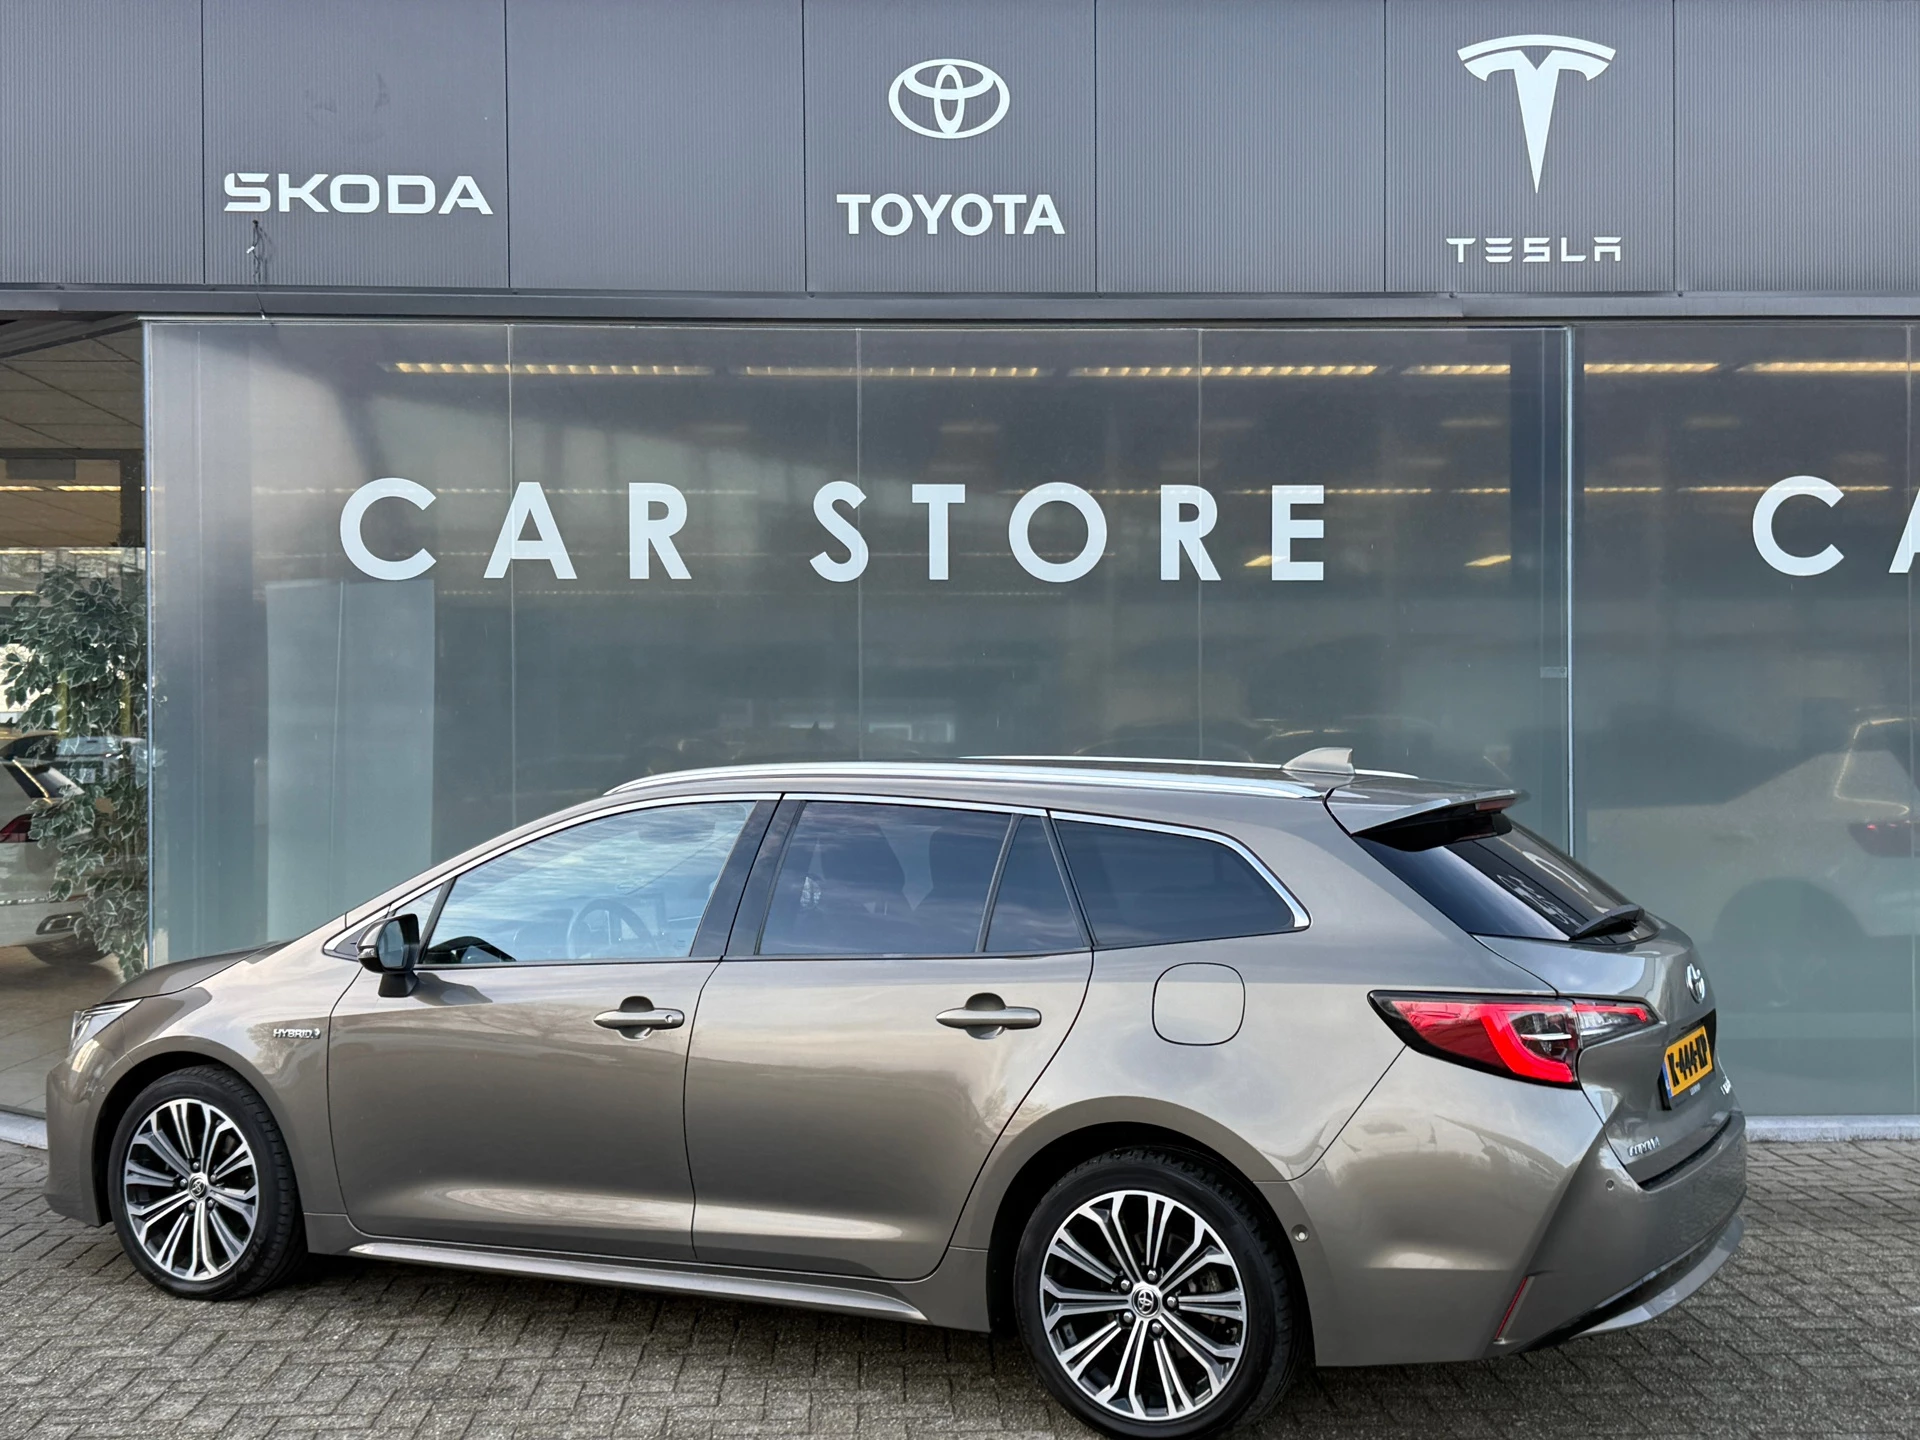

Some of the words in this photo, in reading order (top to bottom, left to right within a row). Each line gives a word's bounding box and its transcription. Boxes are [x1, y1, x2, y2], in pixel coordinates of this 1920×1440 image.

[836, 192, 1066, 237] TOYOTA
[1446, 236, 1623, 264] TESLA
[340, 477, 692, 581] CAR
[809, 481, 1326, 583] STORE
